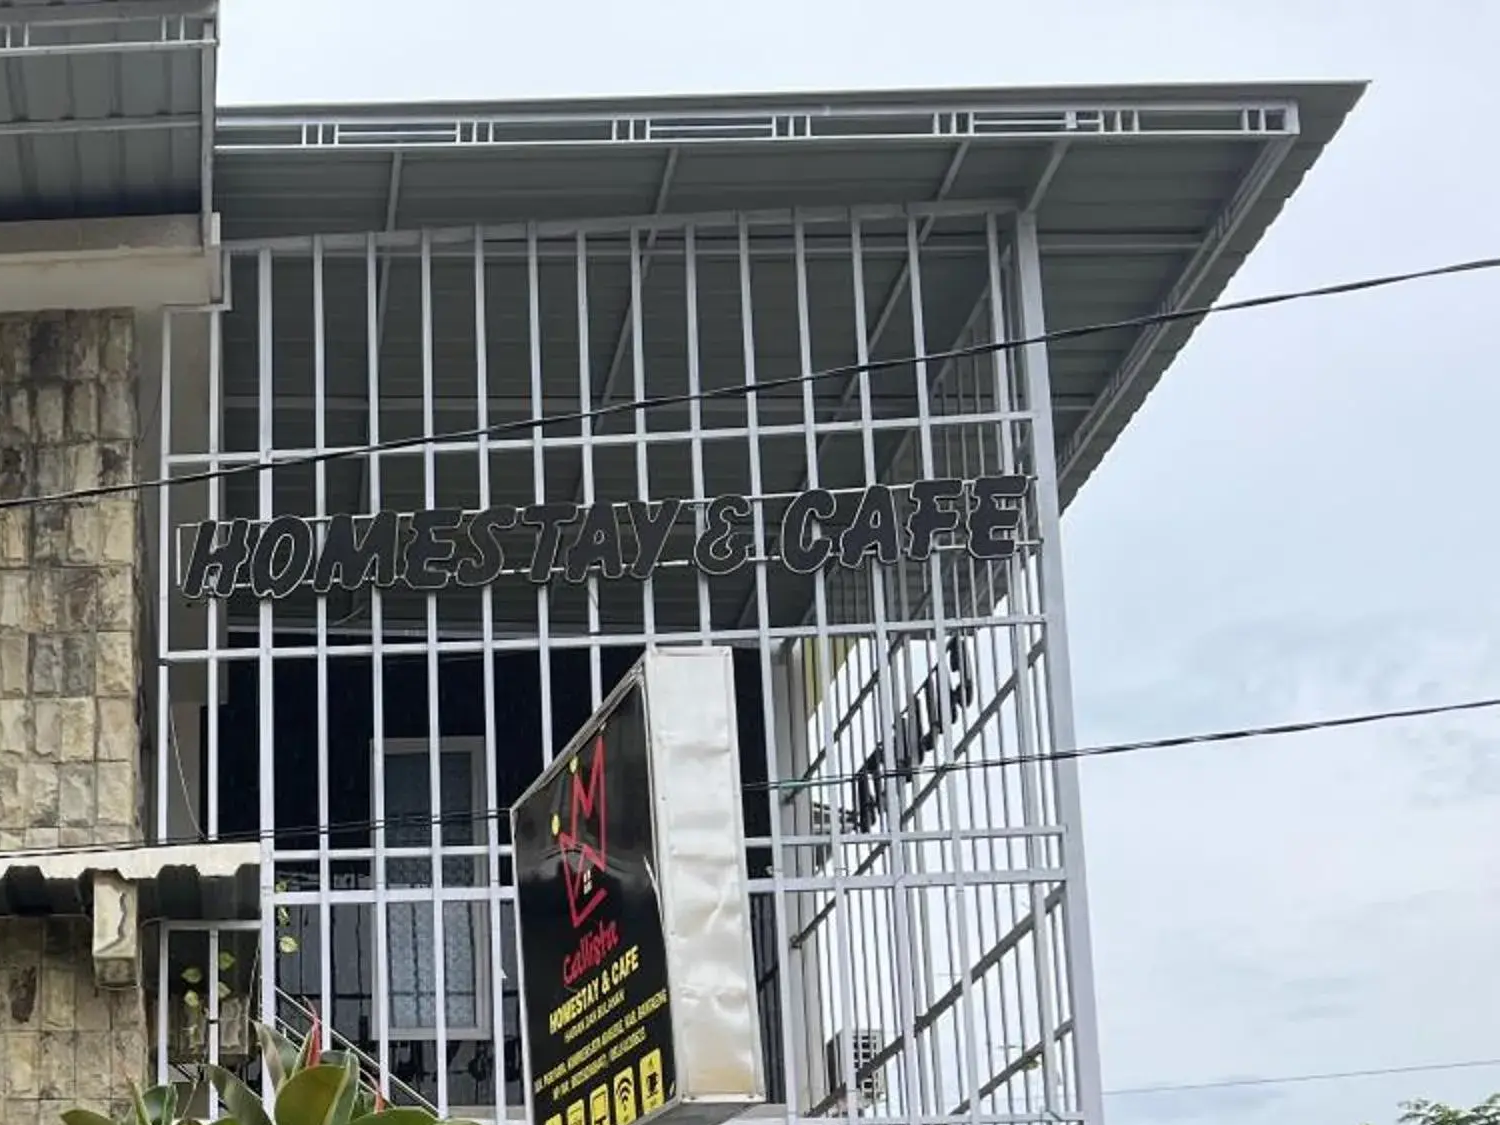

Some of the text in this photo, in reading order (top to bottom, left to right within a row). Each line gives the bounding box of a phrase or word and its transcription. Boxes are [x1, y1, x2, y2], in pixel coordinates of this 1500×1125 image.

[181, 473, 1029, 600] HOMESTAY & CAFE
[549, 945, 640, 1034] HOMESTAY & CAFE
[563, 921, 619, 985] Callista
